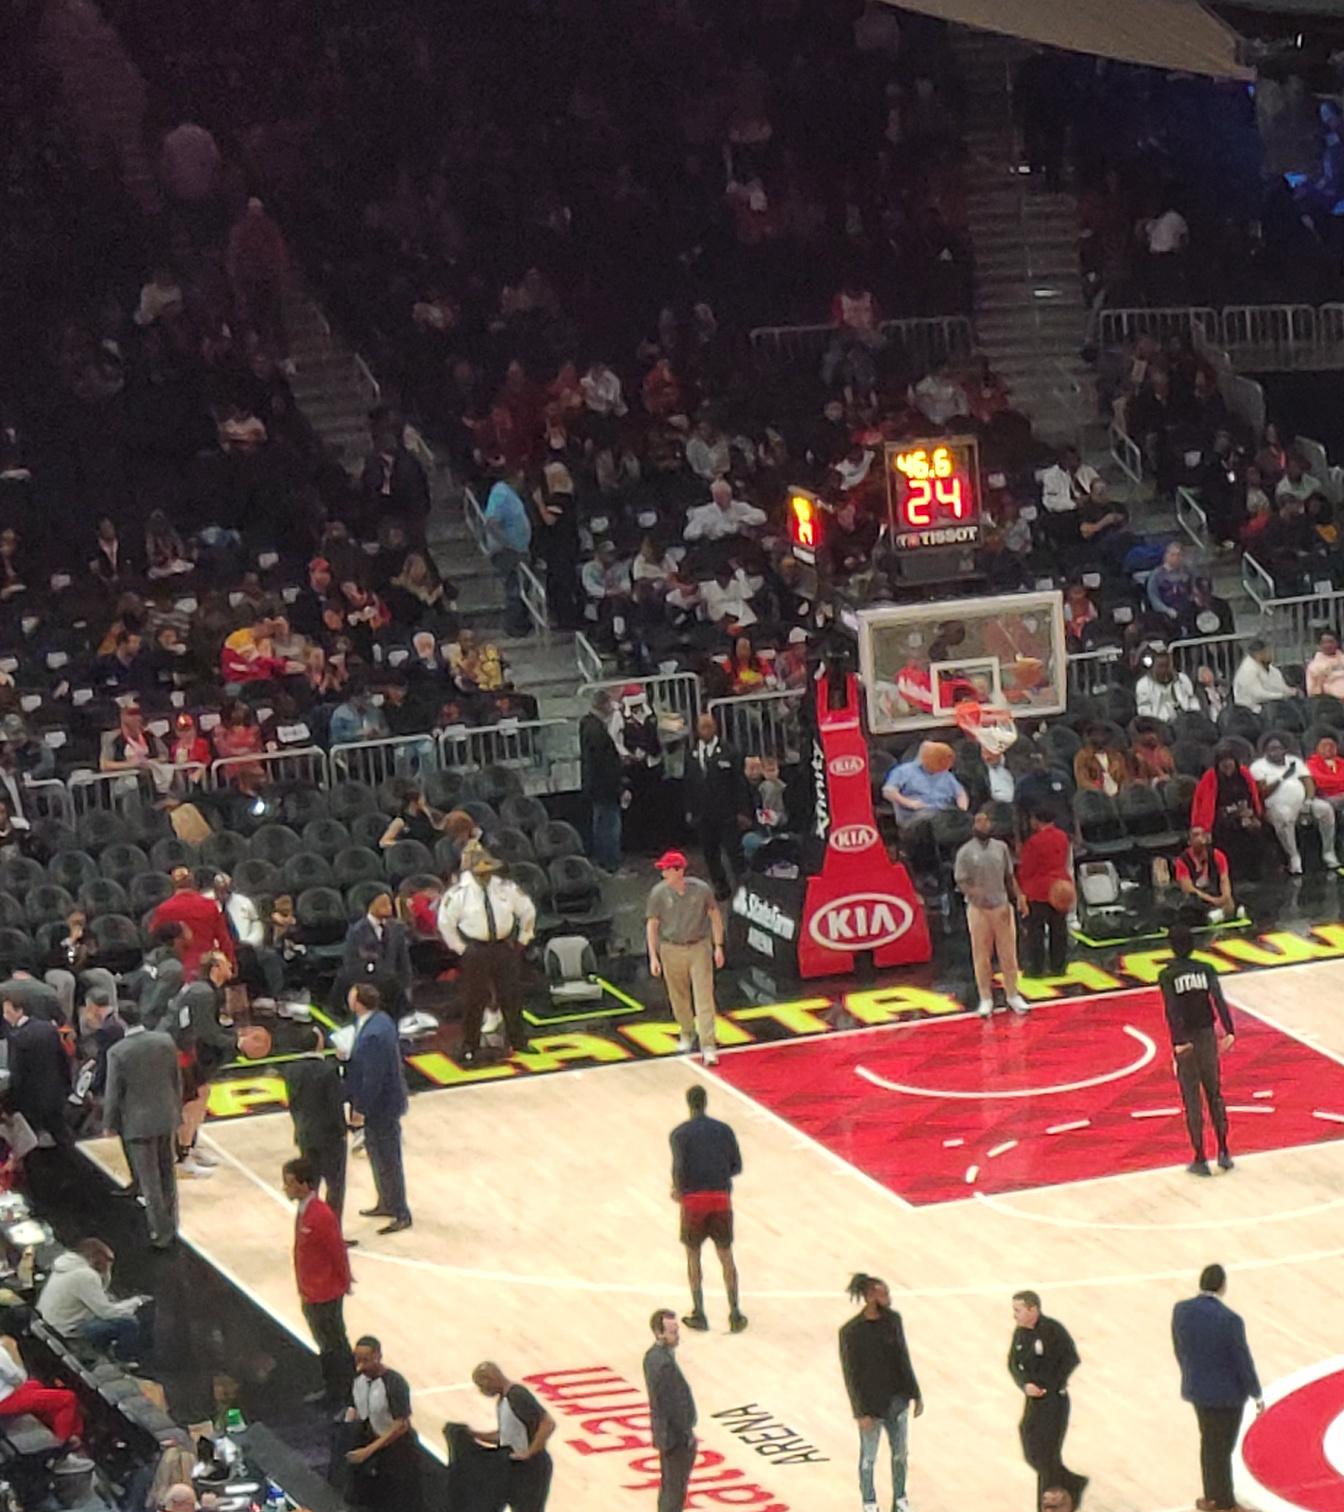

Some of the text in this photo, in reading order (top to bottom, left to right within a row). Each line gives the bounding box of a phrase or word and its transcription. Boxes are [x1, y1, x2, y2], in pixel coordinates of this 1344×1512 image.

[896, 447, 952, 479] 46.6
[907, 477, 962, 525] 24
[919, 526, 978, 546] TISSOT
[831, 757, 861, 773] KIA
[837, 830, 872, 848] KIA
[826, 903, 899, 940] KIA
[1174, 970, 1209, 995] UTAH
[206, 985, 966, 1117] ALANTA
[711, 1403, 830, 1465] ARENA
